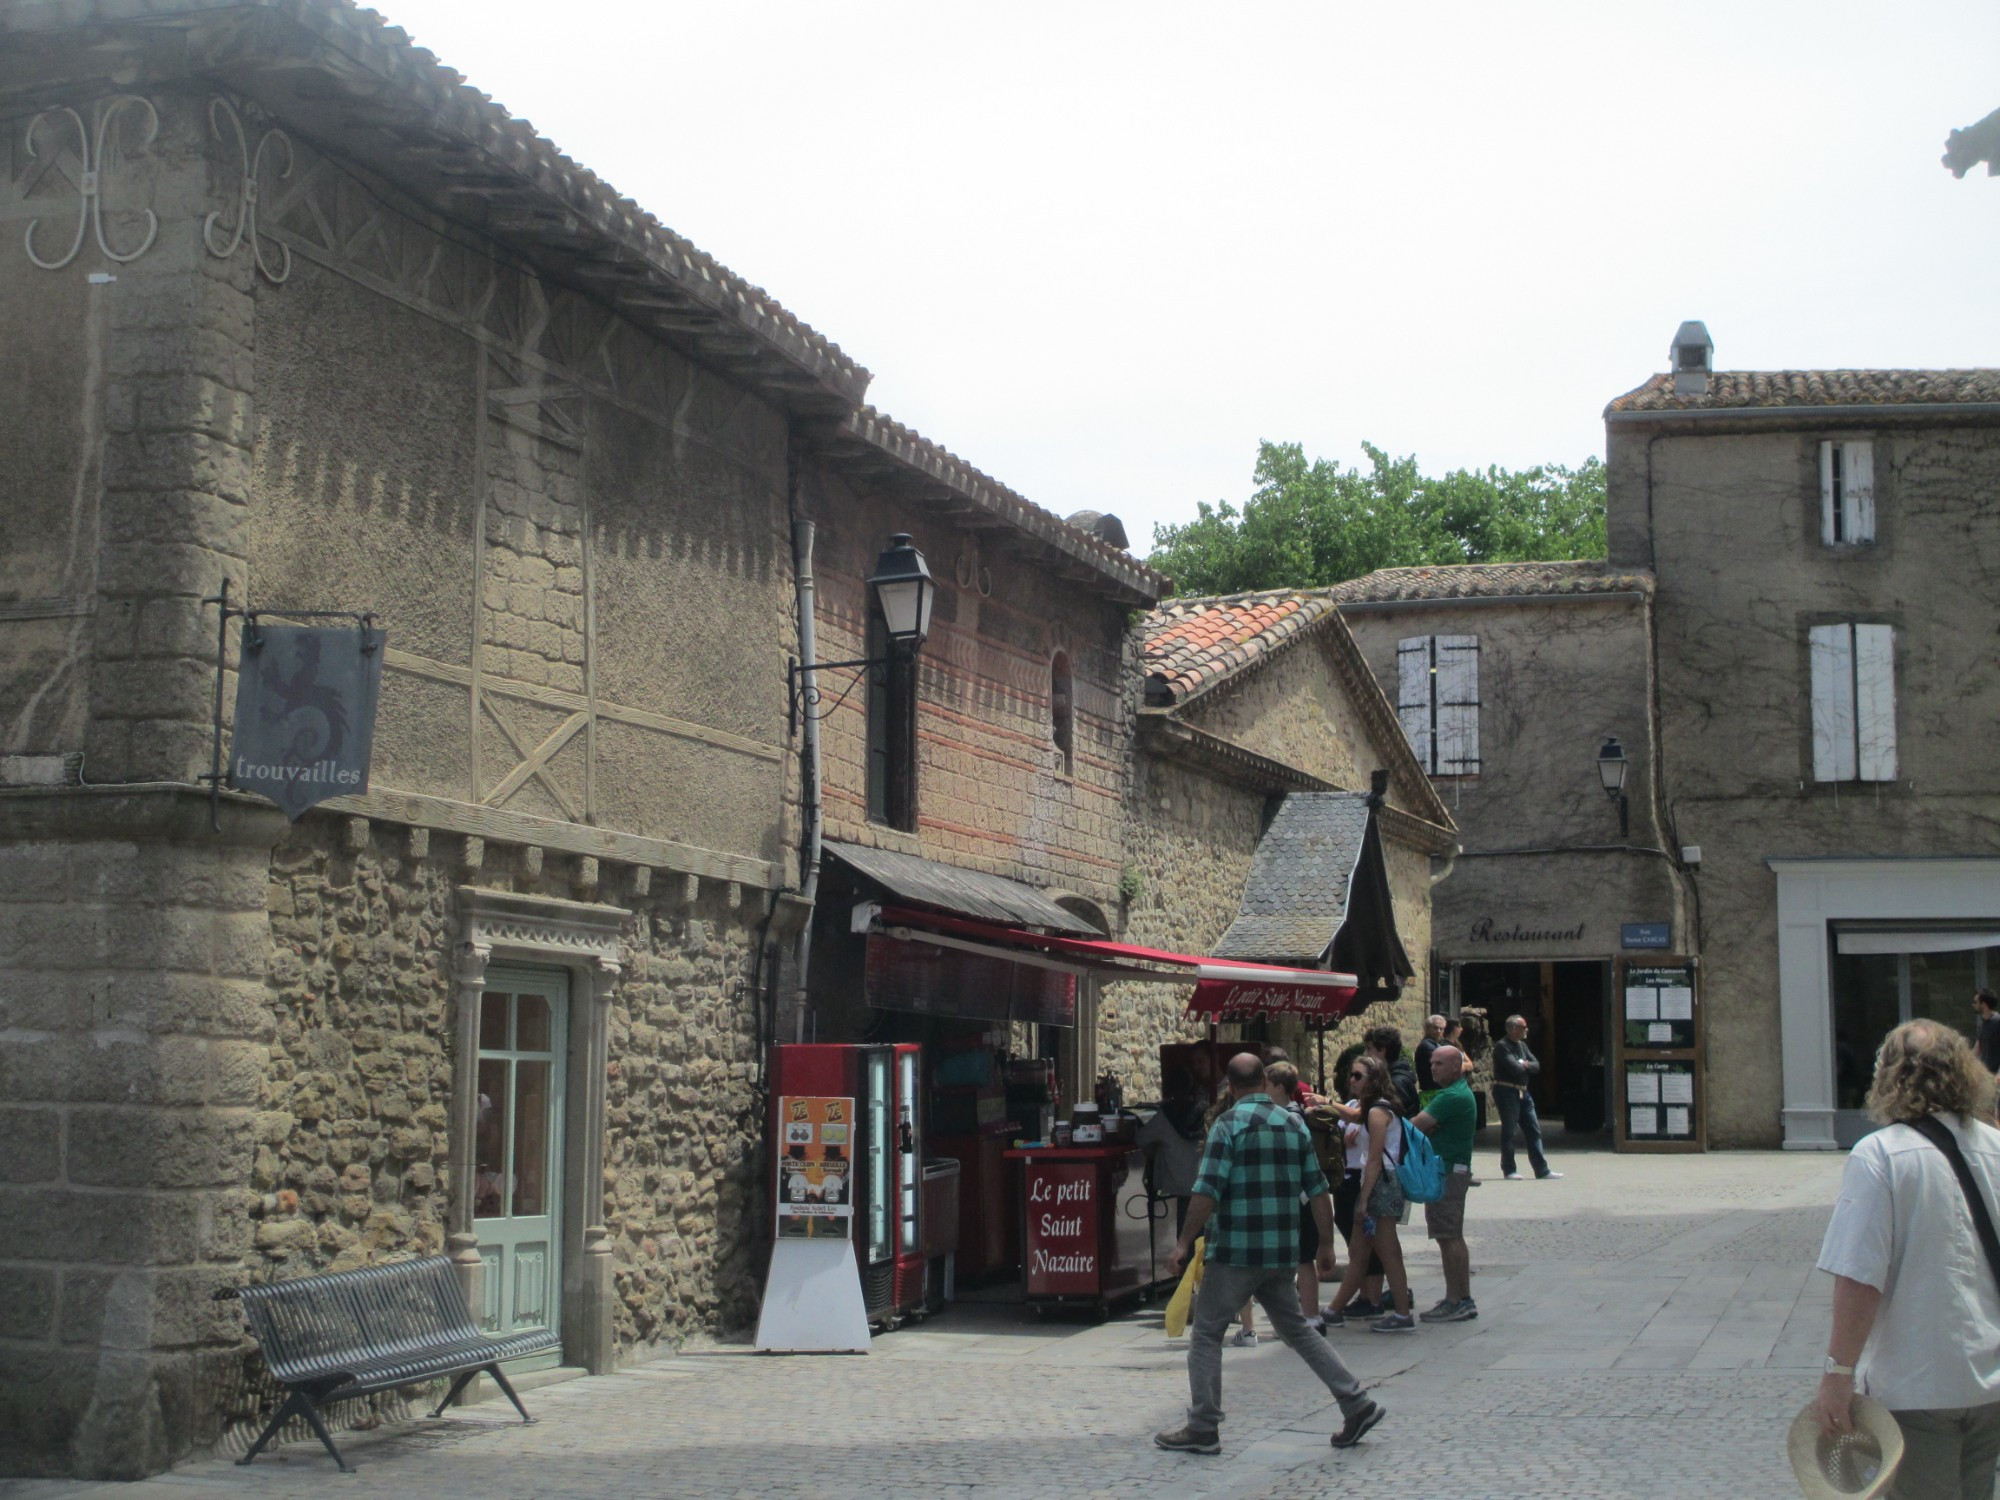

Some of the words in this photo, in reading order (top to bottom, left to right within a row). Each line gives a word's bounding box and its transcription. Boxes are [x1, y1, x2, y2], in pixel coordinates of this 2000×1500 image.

[235, 754, 361, 784] trouvailles
[1470, 918, 1584, 942] Restaurant
[1234, 987, 1263, 1007] petit
[1030, 1178, 1051, 1202] Le
[1057, 1178, 1091, 1205] petit
[1040, 1215, 1082, 1238] Saint
[1031, 1249, 1094, 1276] Nazaire
